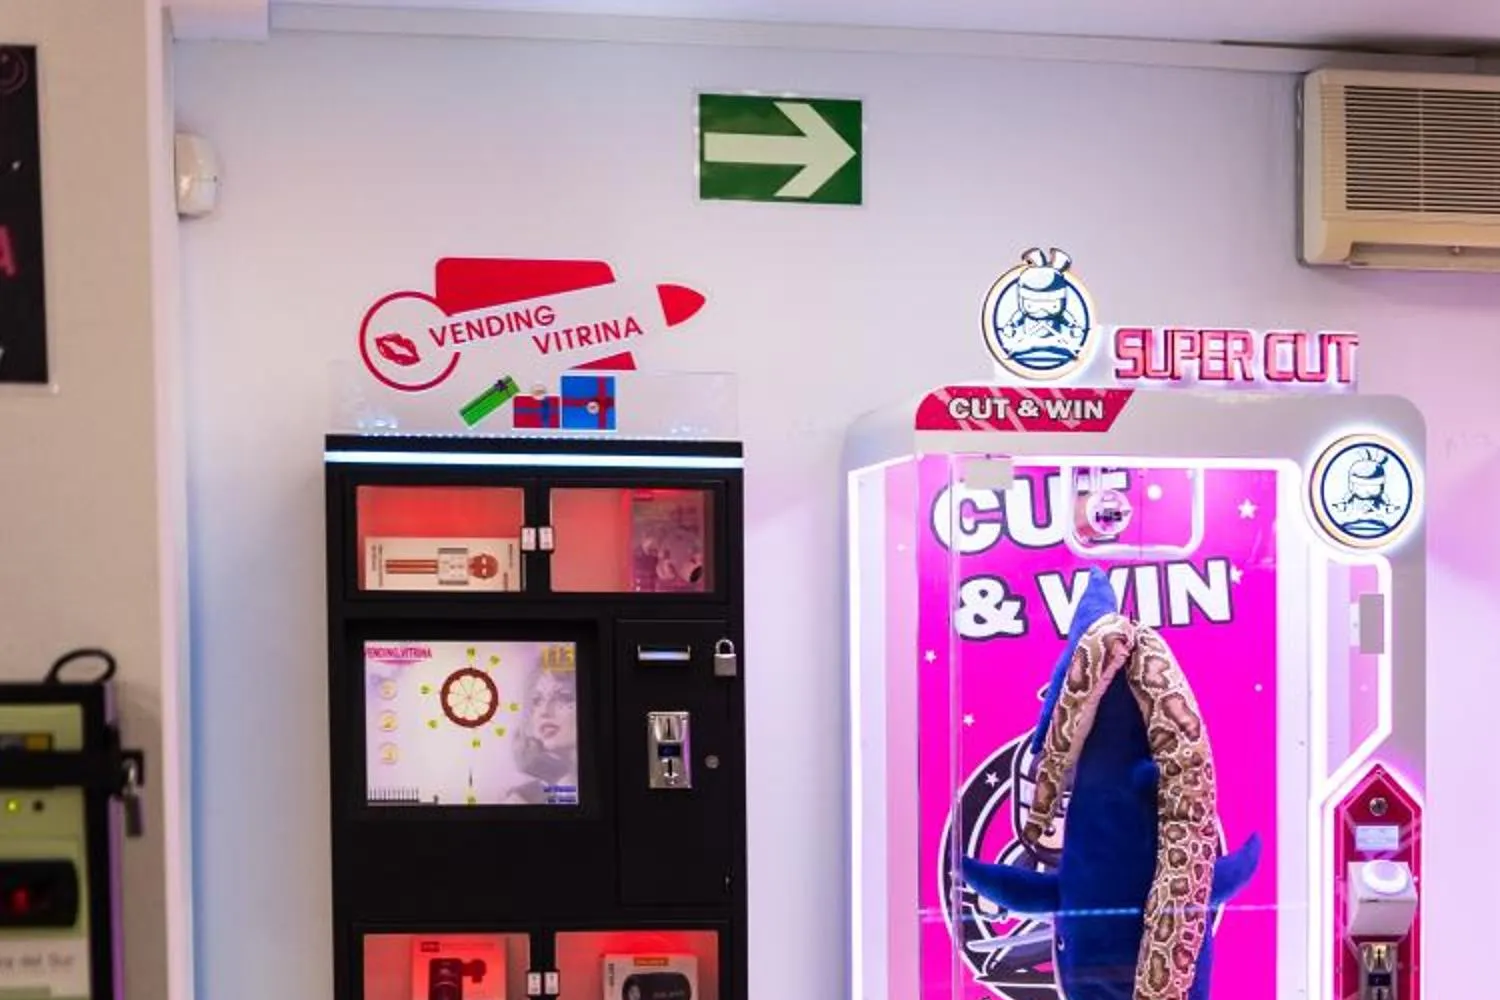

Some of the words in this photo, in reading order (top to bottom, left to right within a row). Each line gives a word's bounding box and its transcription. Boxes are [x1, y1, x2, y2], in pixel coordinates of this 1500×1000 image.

[429, 305, 555, 347] VENDING
[532, 316, 643, 354] VITRINA
[1114, 327, 1255, 381] SUPER
[1264, 330, 1359, 383] CUT
[949, 397, 1010, 420] CUT
[1017, 398, 1040, 418] &
[1045, 398, 1103, 420] WIN
[953, 574, 1029, 641] &
[1034, 556, 1233, 640] WIN
